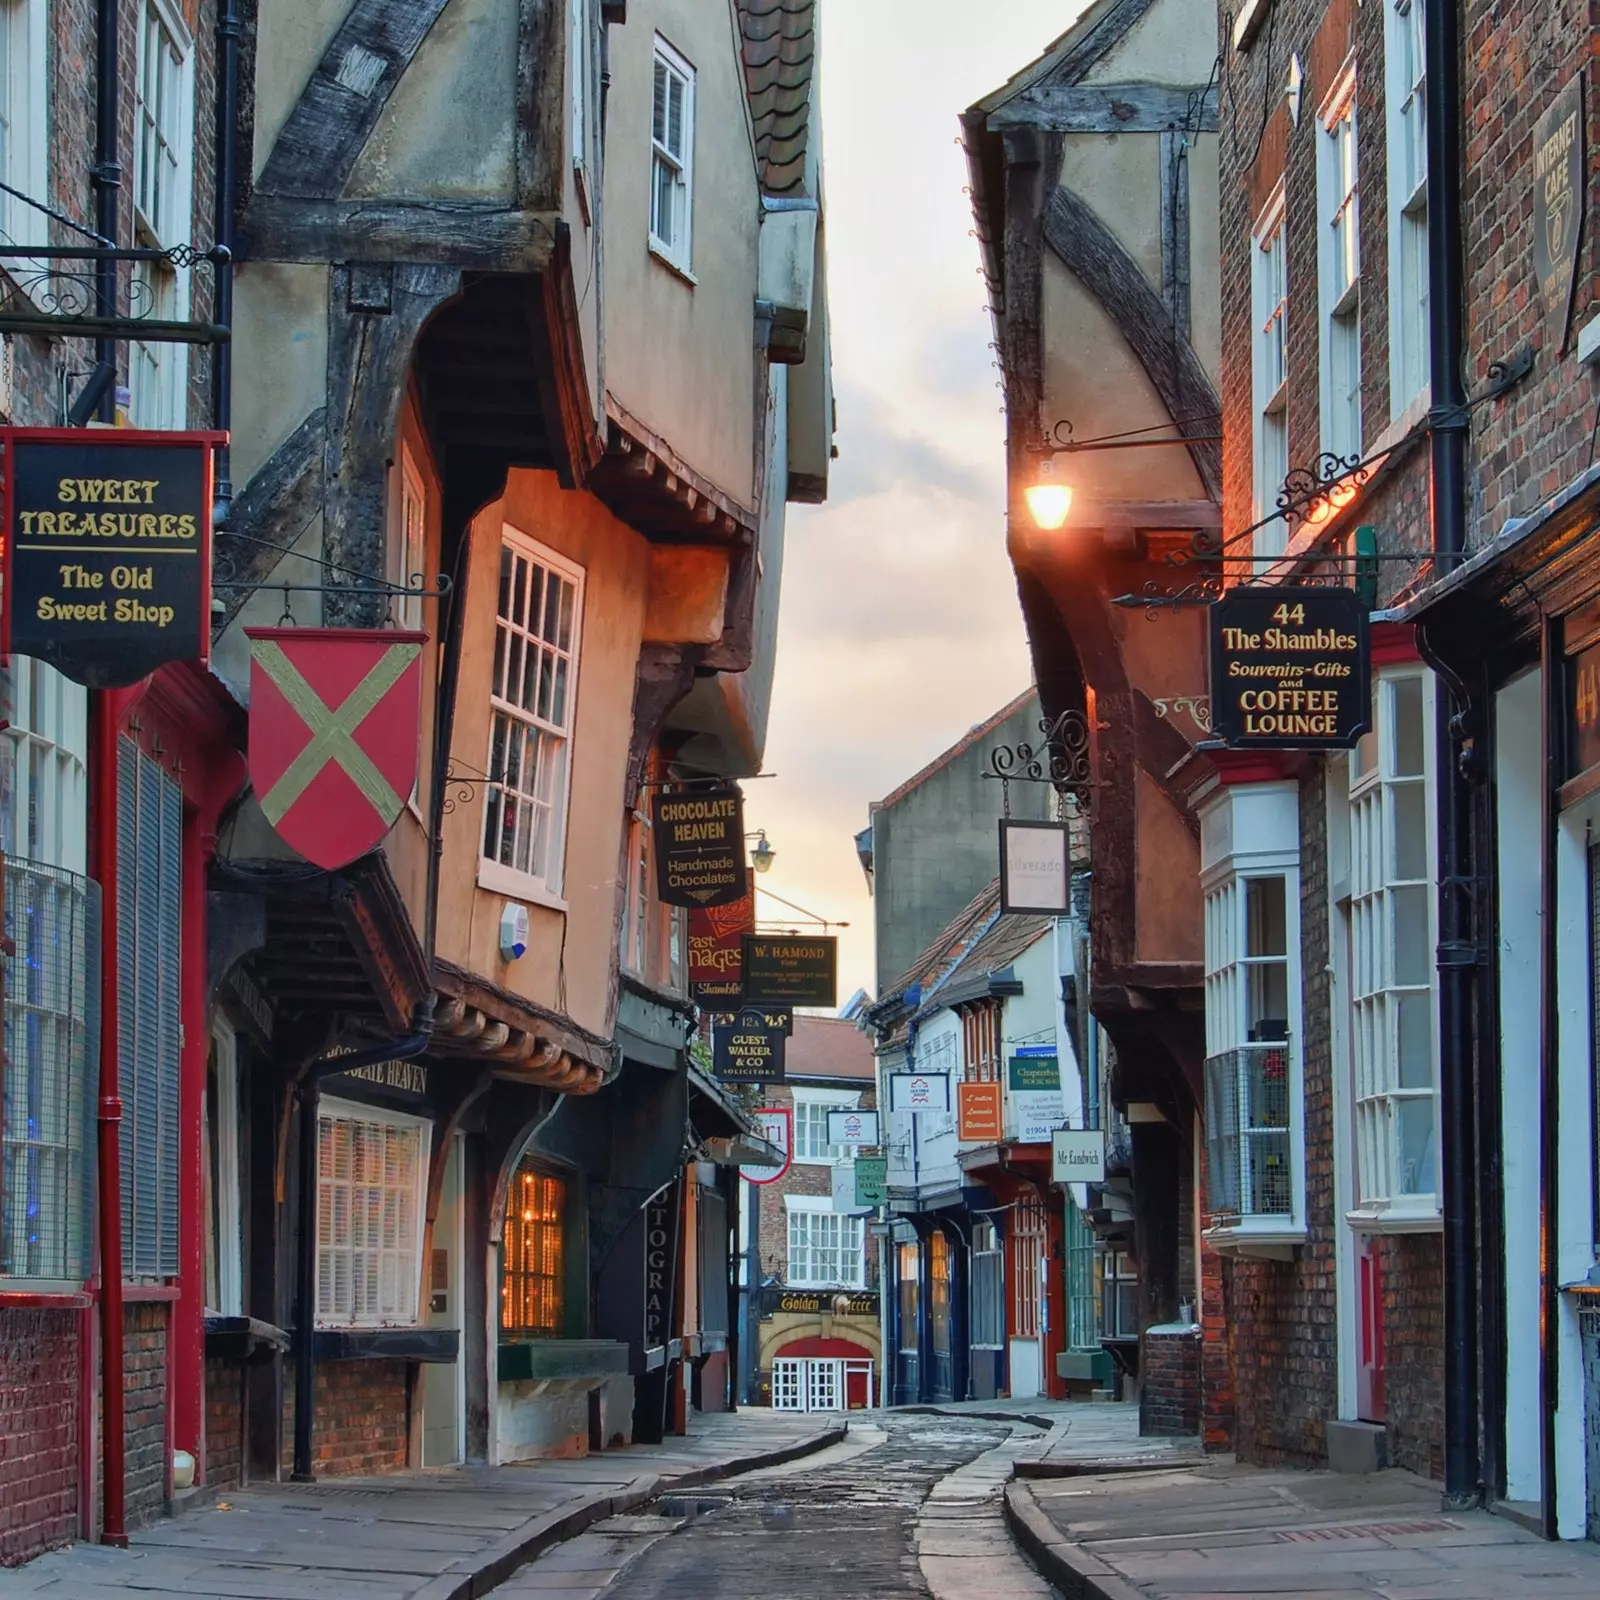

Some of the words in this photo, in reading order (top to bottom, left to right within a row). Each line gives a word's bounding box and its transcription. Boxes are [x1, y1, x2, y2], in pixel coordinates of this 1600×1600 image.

[1536, 110, 1577, 180] INTERNET
[57, 478, 160, 504] SWEET
[19, 511, 196, 539] TREASURES
[59, 565, 104, 588] The
[110, 566, 153, 590] Old
[36, 597, 108, 622] Sweet
[114, 598, 174, 627] Shop
[1273, 603, 1306, 625] 44
[1223, 627, 1262, 650] The
[1264, 627, 1358, 650] Shambles
[1278, 679, 1303, 688] and
[1240, 690, 1339, 711] COFFEE
[1246, 714, 1337, 734] LOUNGE
[660, 800, 737, 821] CHOCOLATE
[674, 822, 725, 842] HEAVEN
[668, 857, 734, 872] Handmade
[668, 873, 736, 887] Chocolates
[772, 946, 825, 959] HAMOND
[732, 1035, 768, 1045] GUEST
[727, 1046, 773, 1056] WALKER
[735, 1058, 745, 1066] &
[746, 1057, 764, 1066] CO
[386, 1059, 428, 1094] HEAVEN
[723, 1068, 776, 1076] SOLICITORS
[1025, 1126, 1047, 1134] 01904
[1057, 1150, 1068, 1164] Mr
[781, 1298, 819, 1310] Golden
